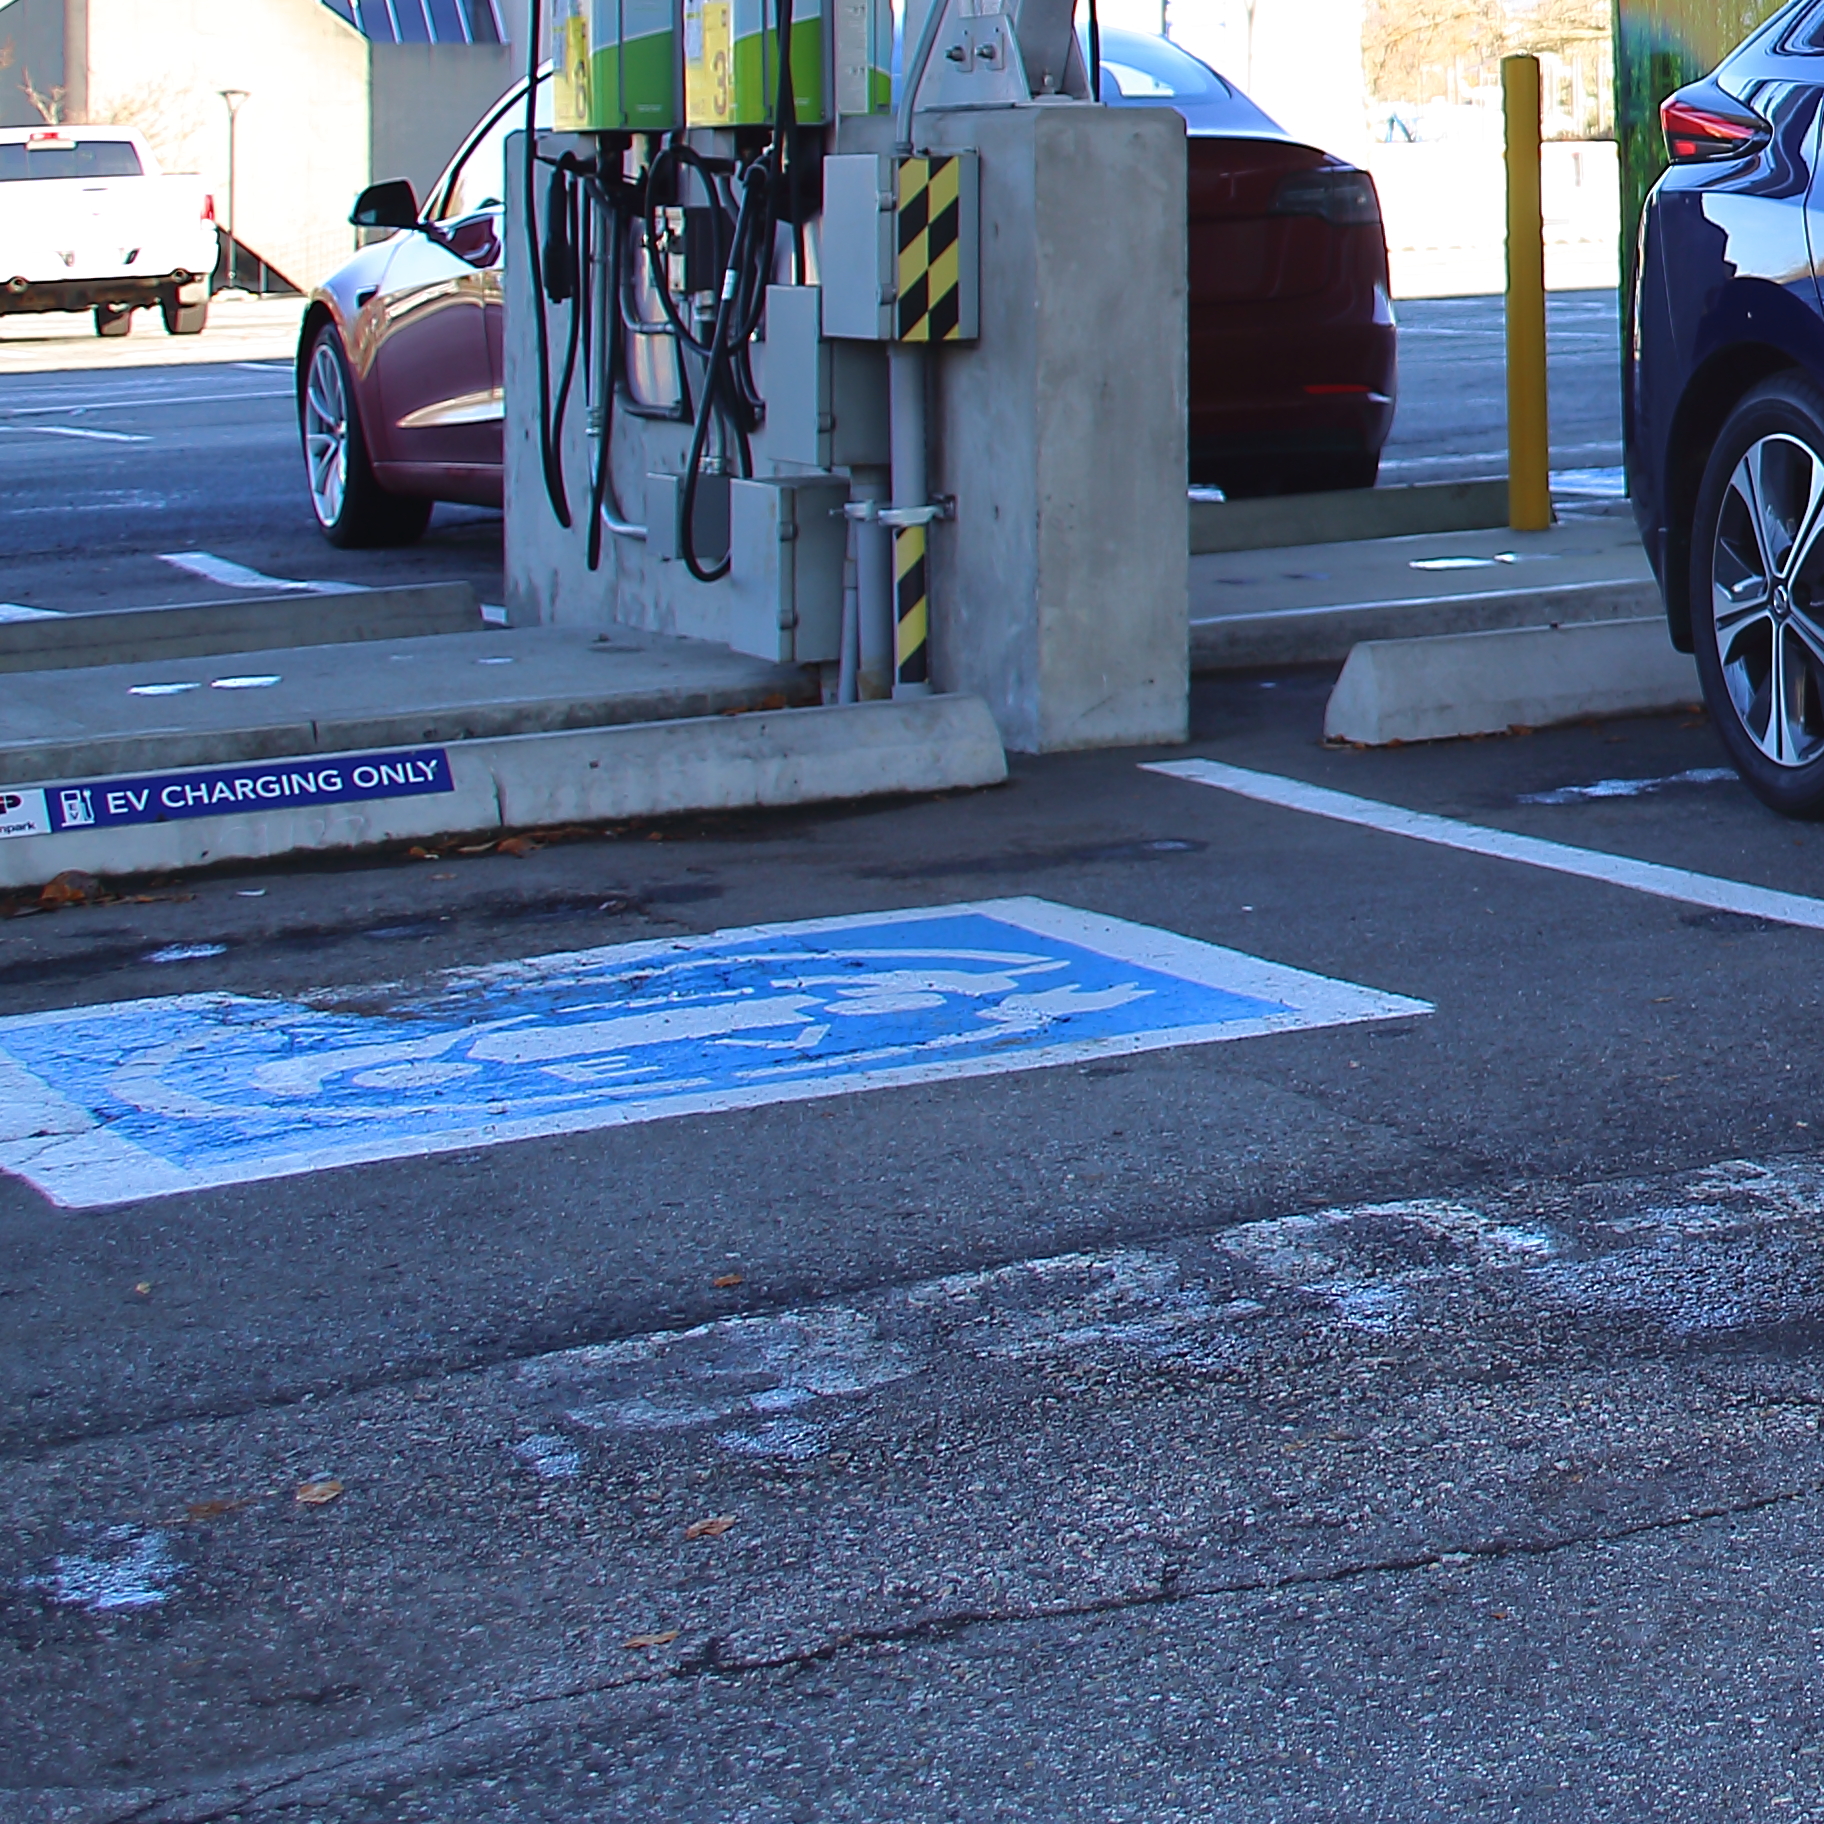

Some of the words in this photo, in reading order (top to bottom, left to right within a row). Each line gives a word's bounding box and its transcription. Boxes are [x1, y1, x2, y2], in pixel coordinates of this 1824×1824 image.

[107, 788, 151, 815] EV
[160, 768, 343, 809] CHARGING
[352, 759, 439, 789] ONLY
